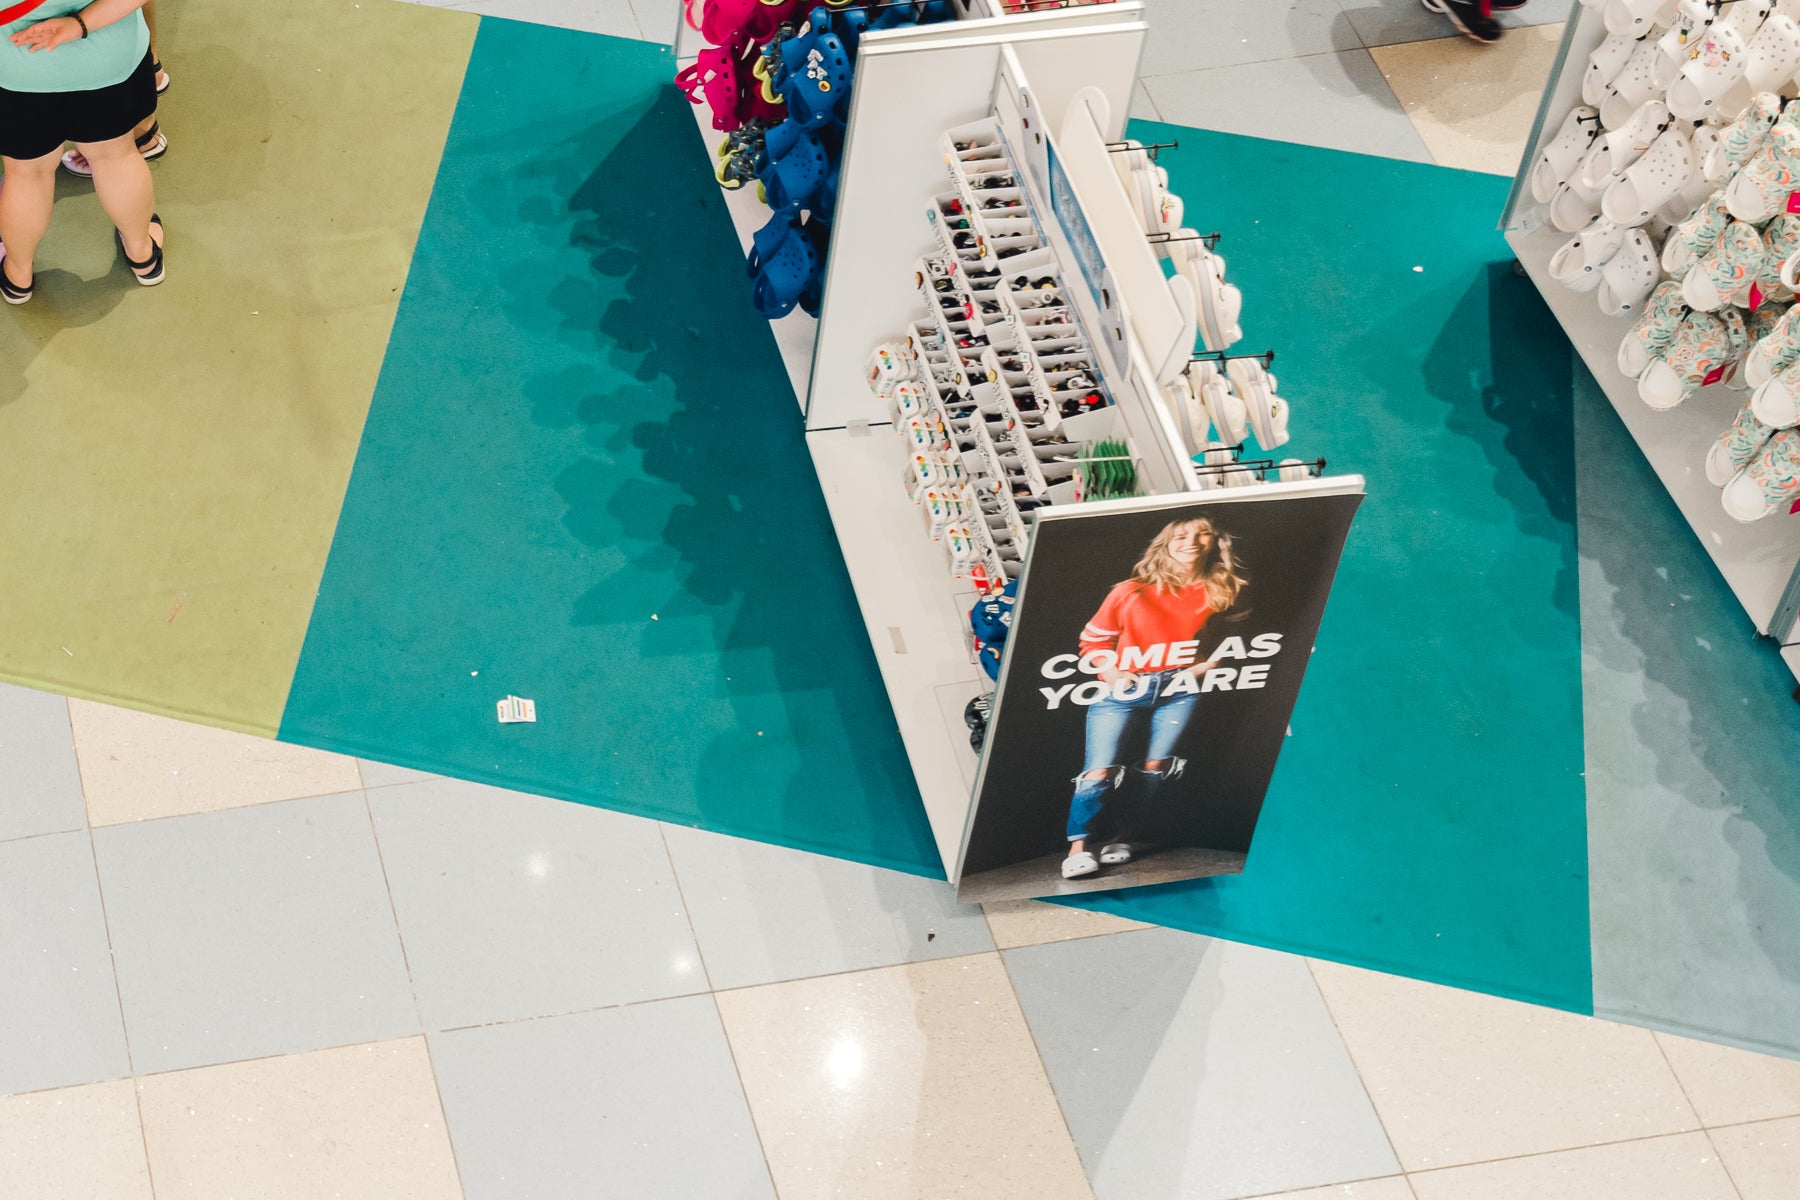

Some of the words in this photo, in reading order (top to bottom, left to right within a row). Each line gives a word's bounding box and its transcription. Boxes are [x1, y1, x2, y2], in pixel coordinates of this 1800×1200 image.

[1040, 639, 1201, 680] COME
[1209, 632, 1285, 661] AS
[1039, 674, 1150, 711] YOU
[1159, 664, 1271, 698] ARE
